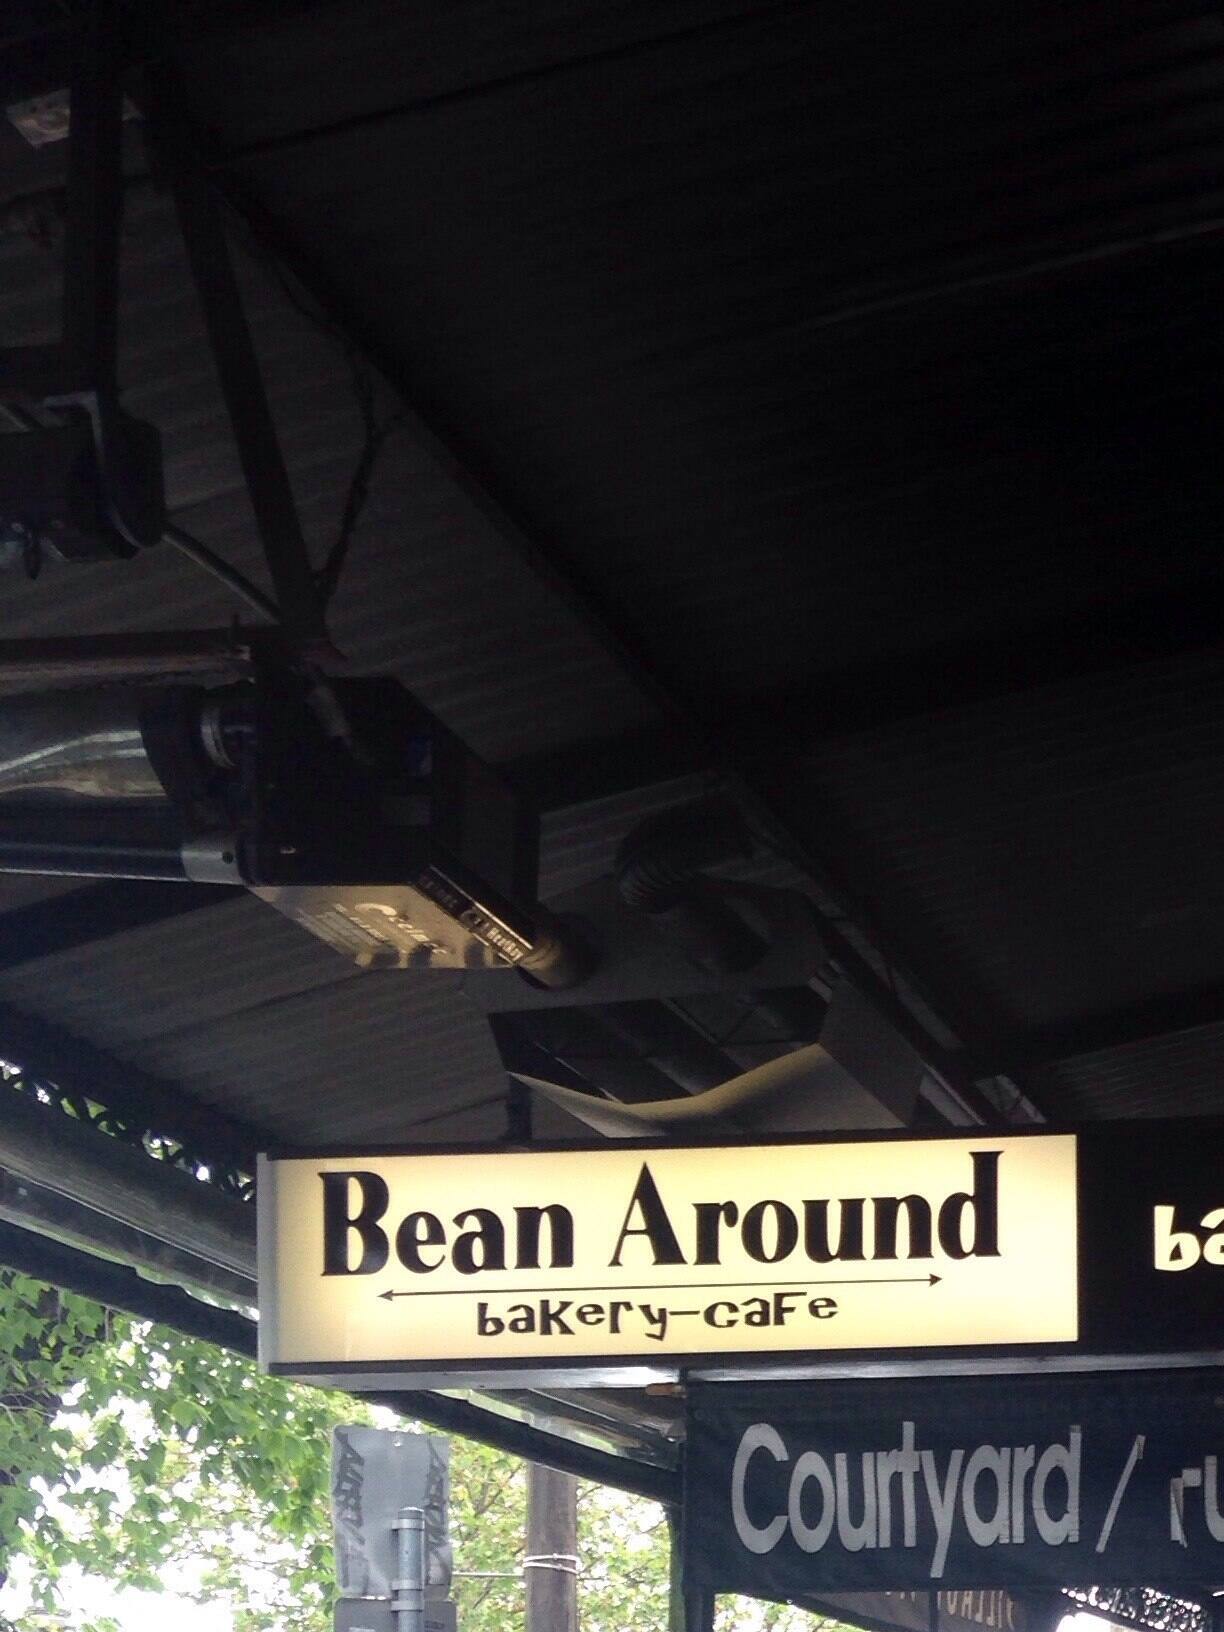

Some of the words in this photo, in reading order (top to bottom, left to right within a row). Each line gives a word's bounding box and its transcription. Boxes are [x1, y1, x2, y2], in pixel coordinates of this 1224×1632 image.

[317, 1171, 574, 1277] Bean
[608, 1150, 1003, 1267] Around
[731, 1420, 1082, 1579] Courtyard
